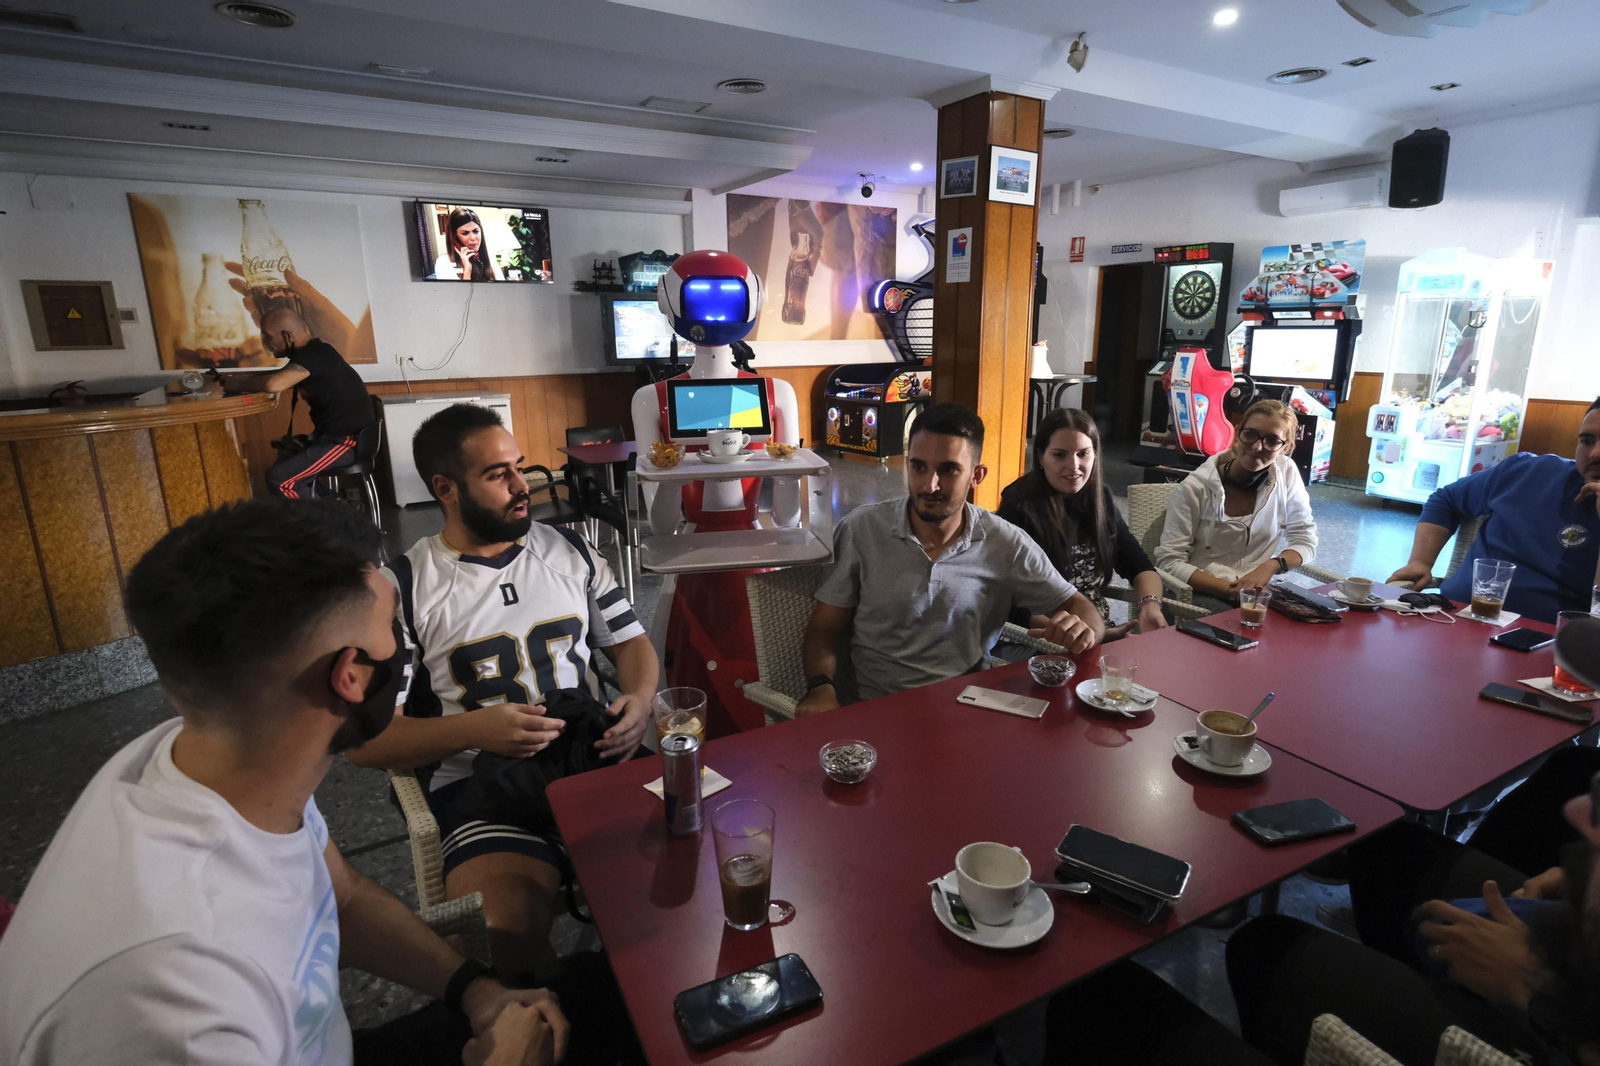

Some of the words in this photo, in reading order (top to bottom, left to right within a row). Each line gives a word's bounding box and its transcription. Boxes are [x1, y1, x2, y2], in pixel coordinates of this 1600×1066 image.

[1112, 244, 1142, 253] SERVICIOS
[499, 582, 519, 606] D
[447, 613, 585, 712] 80
